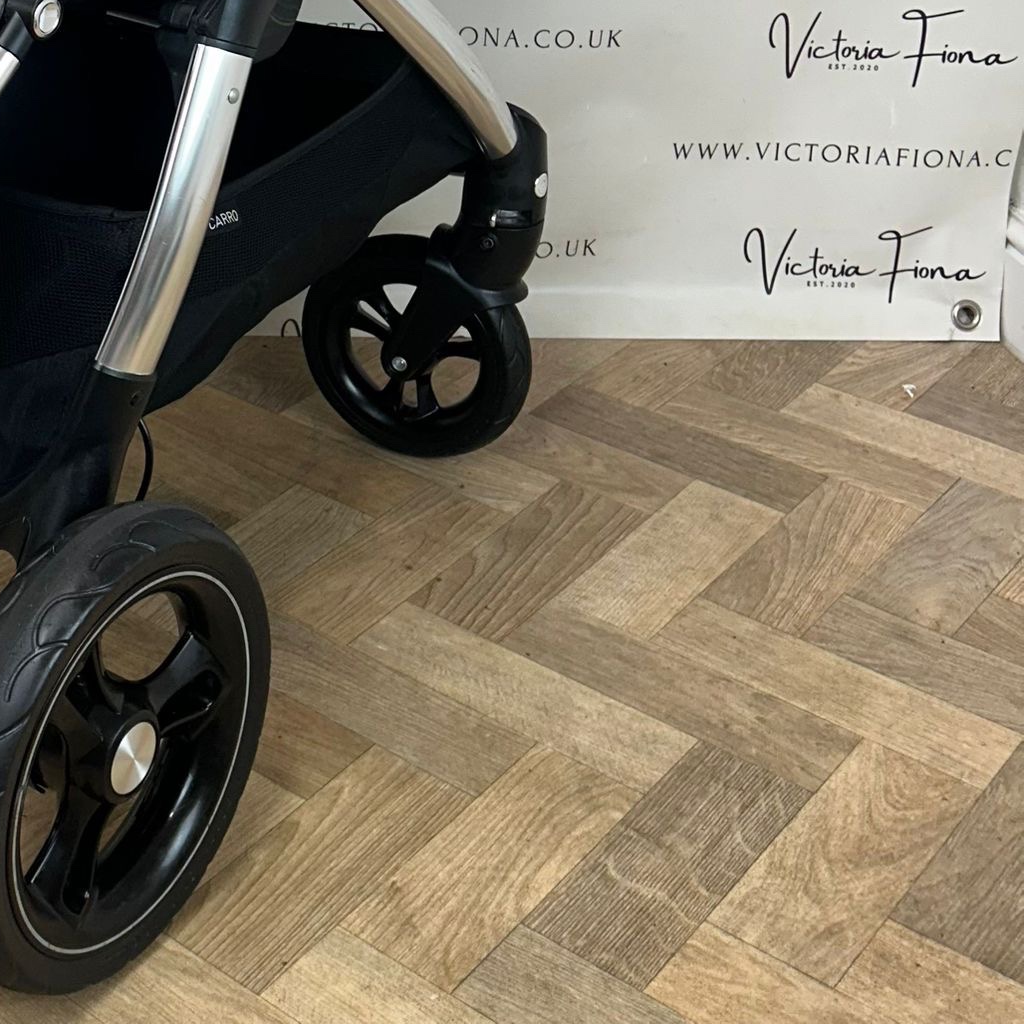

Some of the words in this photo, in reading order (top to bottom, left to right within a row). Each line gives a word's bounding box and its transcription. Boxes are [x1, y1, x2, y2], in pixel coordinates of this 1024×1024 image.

[769, 11, 901, 79] Victoria
[902, 9, 1018, 88] Fiona
[743, 227, 877, 295] Victoria
[878, 226, 986, 303] Fiona
